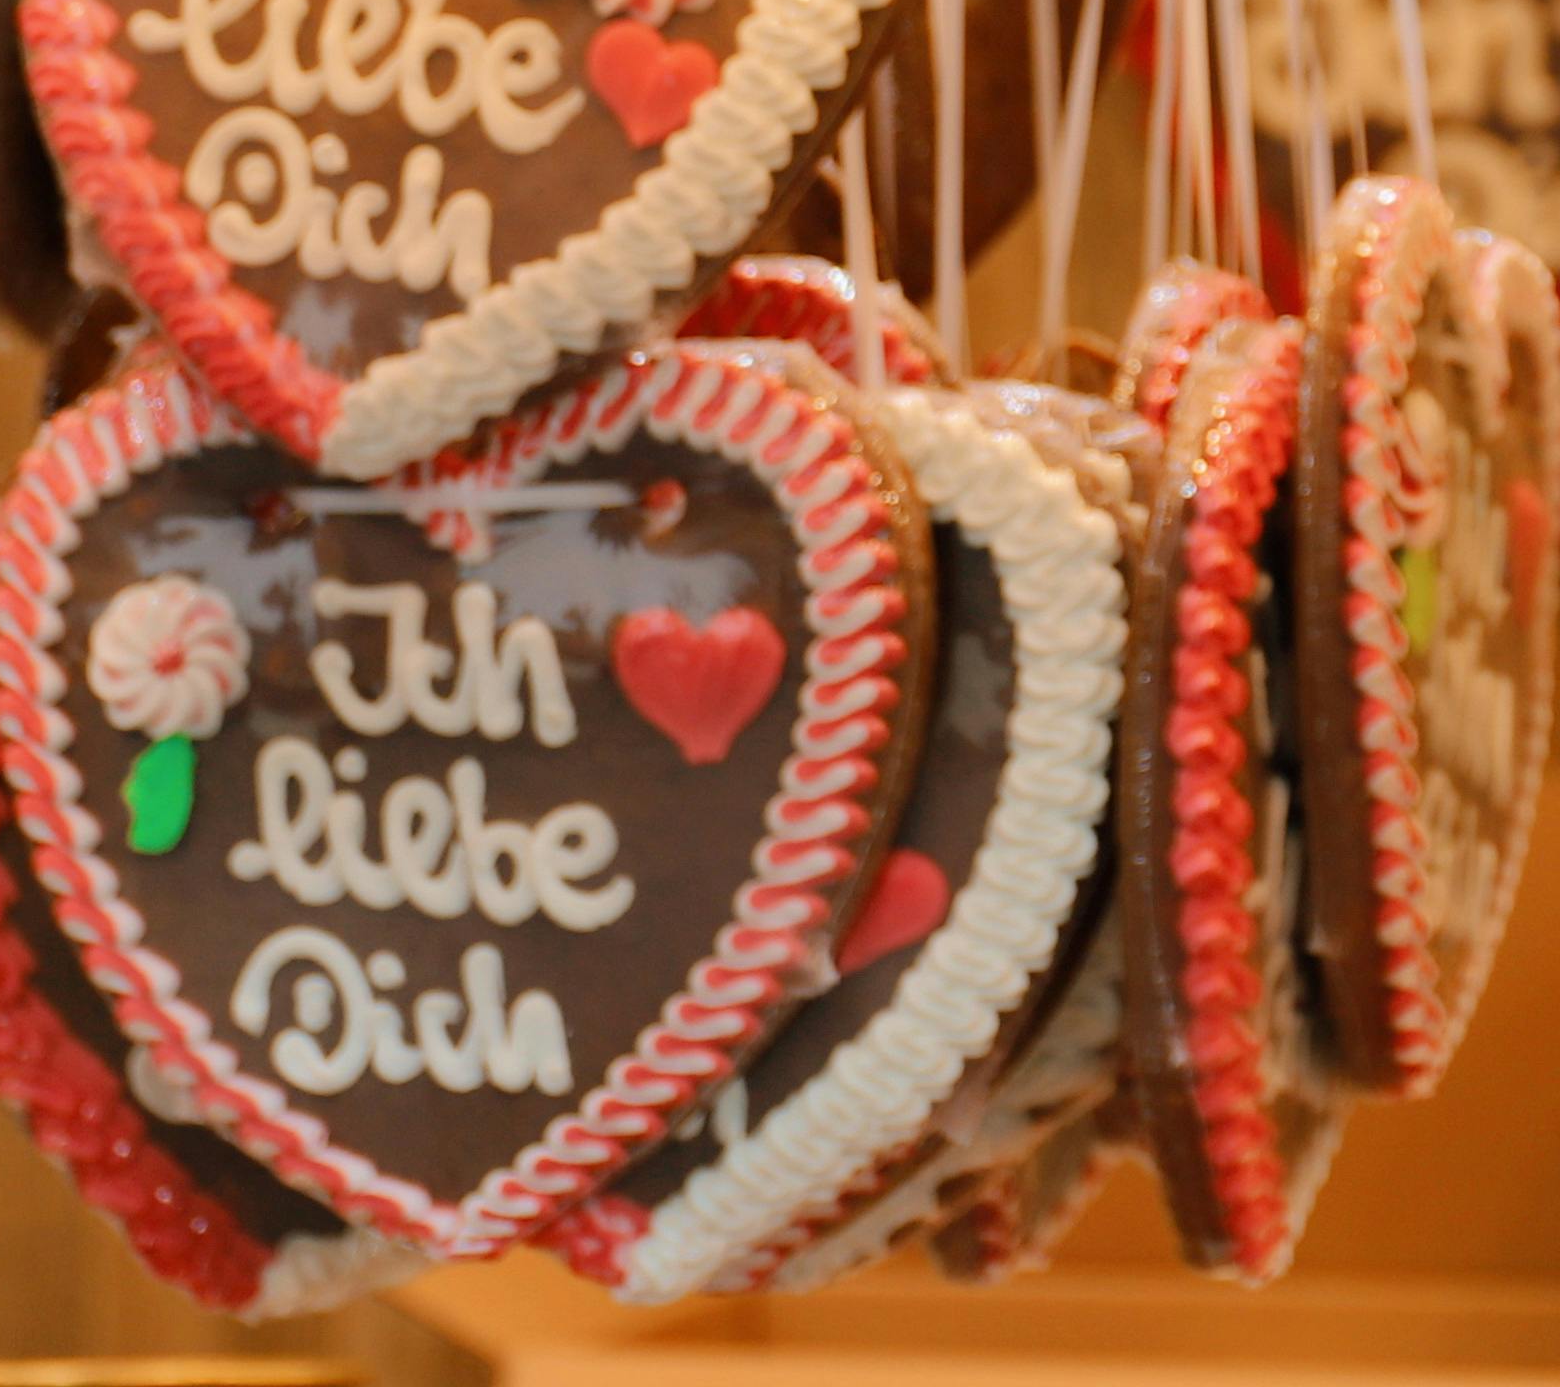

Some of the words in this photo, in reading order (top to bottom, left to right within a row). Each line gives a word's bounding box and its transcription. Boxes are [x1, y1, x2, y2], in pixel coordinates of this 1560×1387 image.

[185, 106, 494, 299] Dich
[310, 577, 577, 748] Ich
[226, 734, 636, 933] liebe
[231, 925, 574, 1097] Dich
